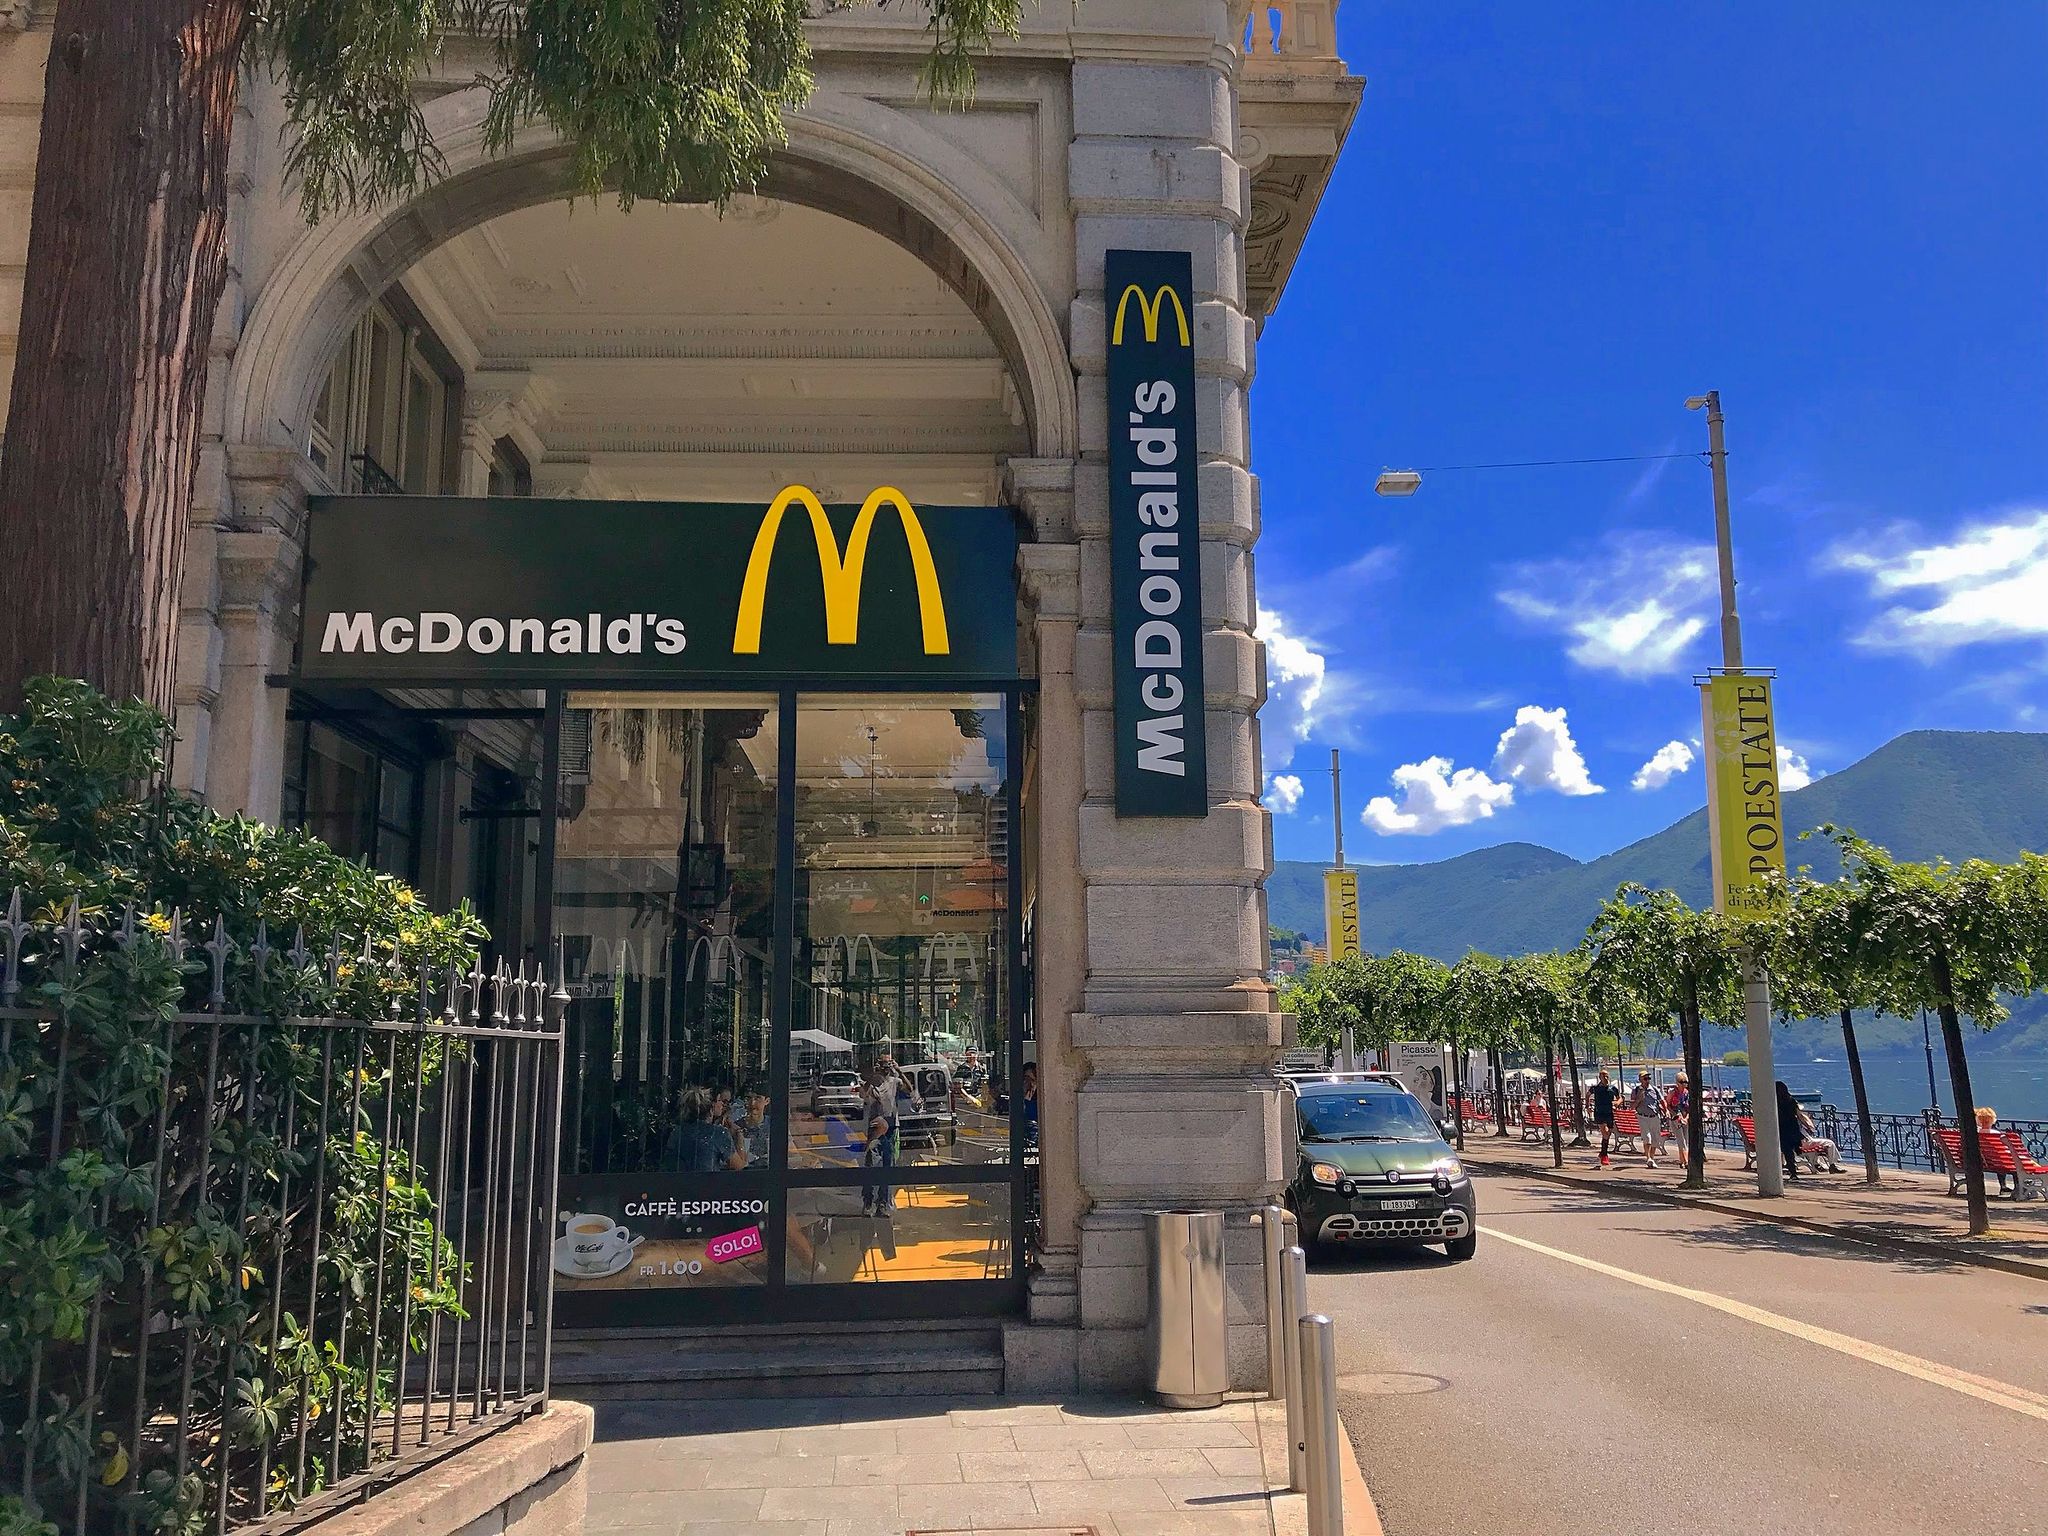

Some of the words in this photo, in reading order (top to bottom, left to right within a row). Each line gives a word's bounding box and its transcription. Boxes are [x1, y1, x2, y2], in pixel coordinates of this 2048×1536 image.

[1129, 379, 1186, 777] McDonald's
[320, 612, 686, 655] McDonald's
[1737, 684, 1779, 876] POESTATE
[1341, 877, 1358, 957] OESTATE
[1401, 1045, 1436, 1054] Picasso
[624, 1198, 677, 1217] CAFFÈ
[681, 1200, 763, 1215] ESPRESSO
[713, 1233, 758, 1257] SOLO!
[640, 1266, 656, 1276] FR.
[659, 1260, 702, 1275] 1.00
